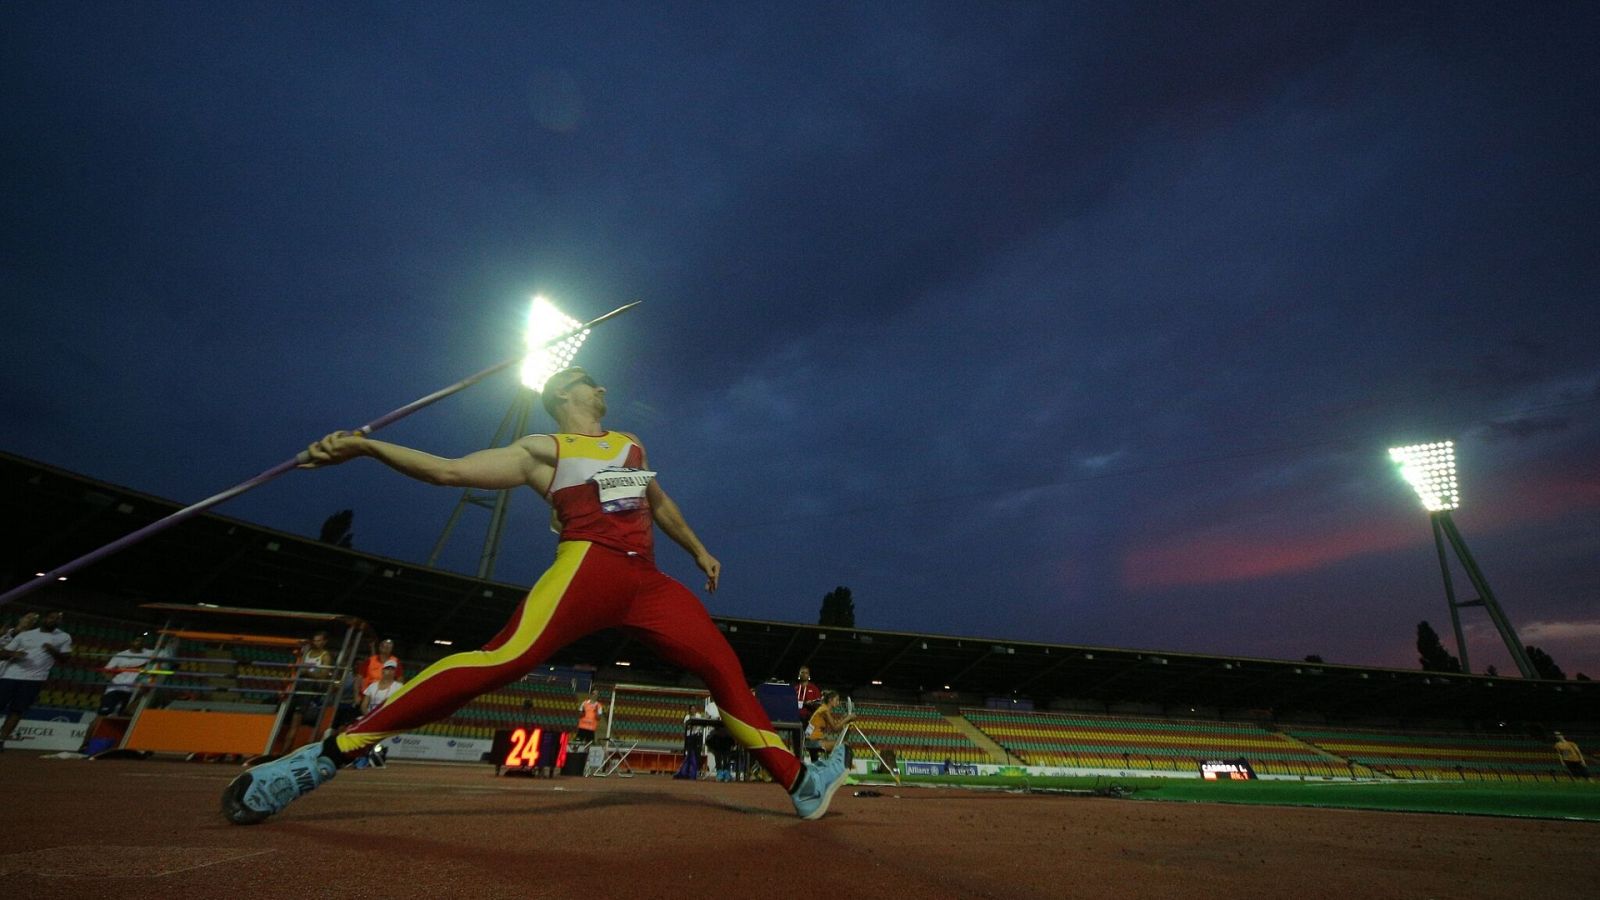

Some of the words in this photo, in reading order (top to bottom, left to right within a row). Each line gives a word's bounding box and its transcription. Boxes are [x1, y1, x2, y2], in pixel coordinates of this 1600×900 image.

[16, 727, 55, 737] PIEGEL
[505, 727, 541, 767] 24
[908, 766, 931, 775] Allianz
